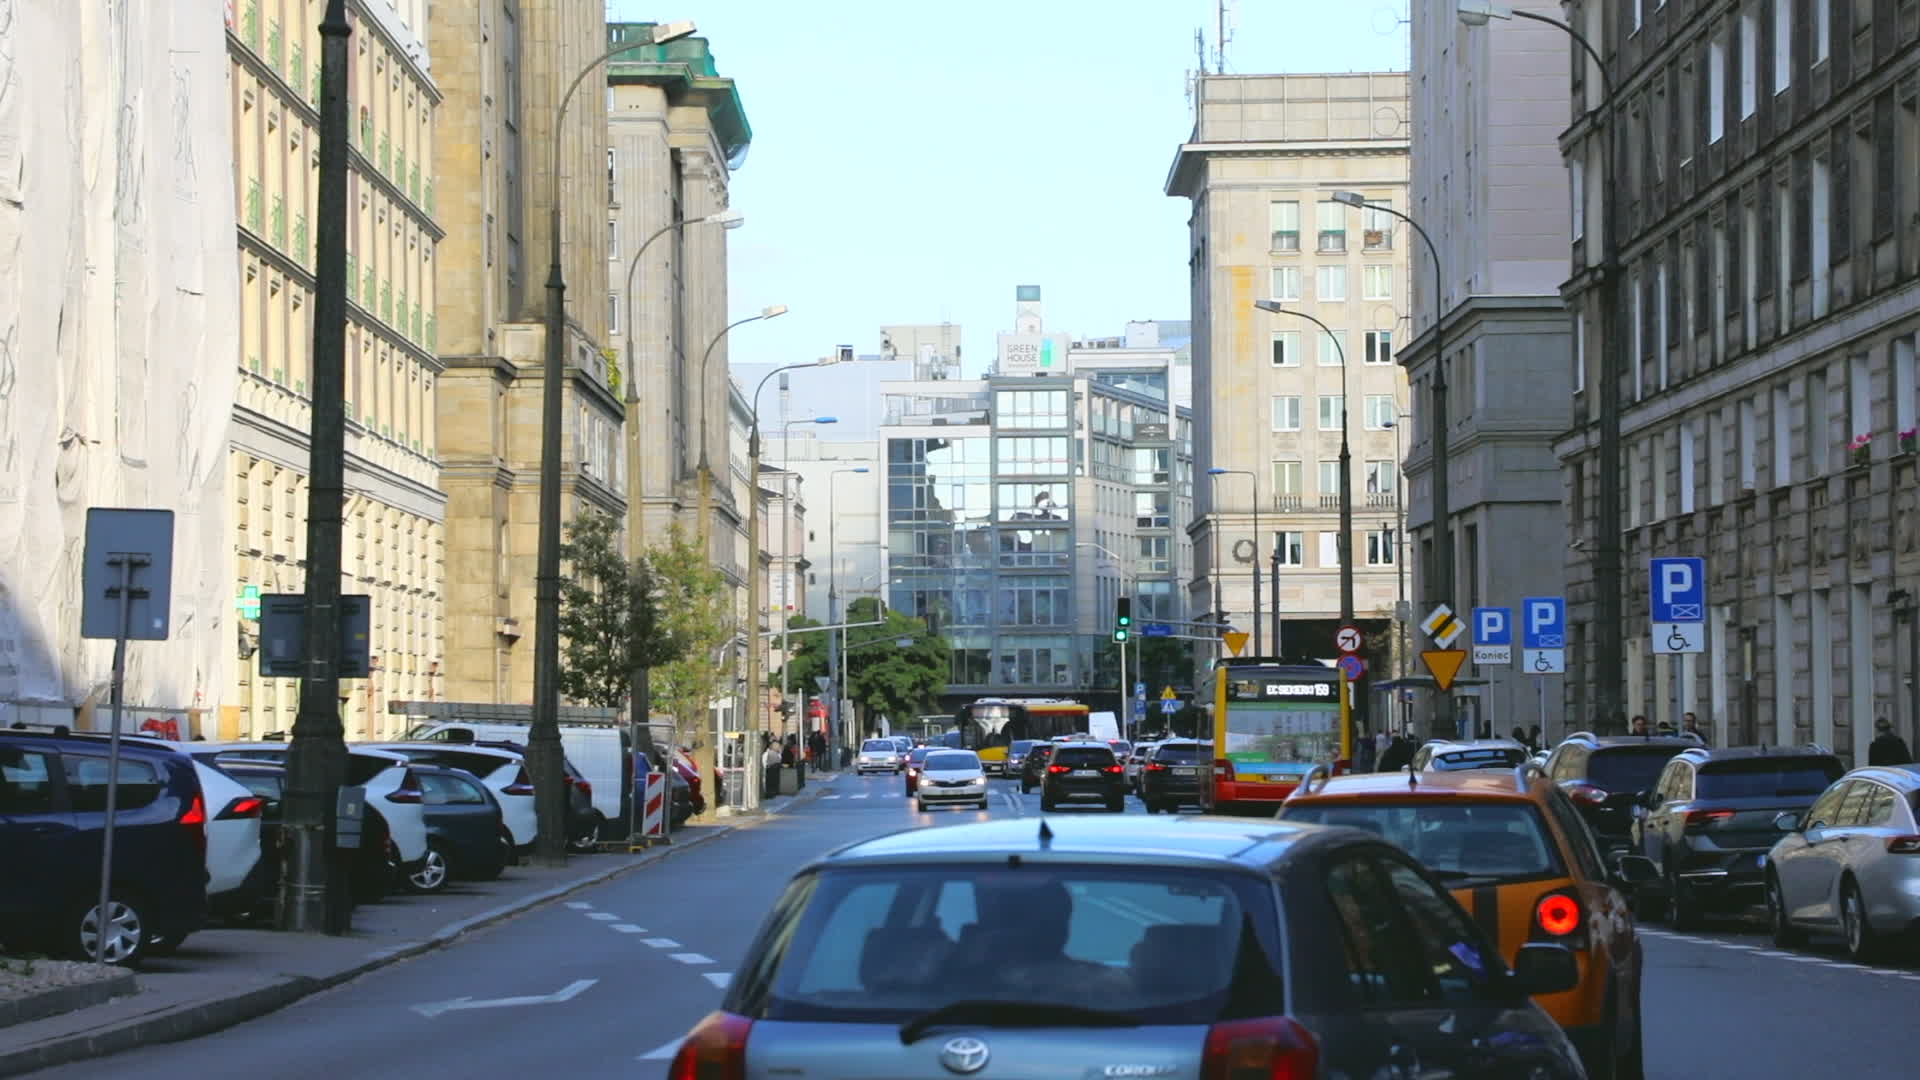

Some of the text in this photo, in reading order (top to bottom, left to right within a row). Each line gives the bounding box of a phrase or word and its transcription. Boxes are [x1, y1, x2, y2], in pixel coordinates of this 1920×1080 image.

[1007, 344, 1038, 353] GREEN
[1007, 354, 1038, 362] HOUSE
[1662, 564, 1692, 604] P
[1481, 611, 1503, 641] P
[1531, 602, 1555, 634] P
[1475, 651, 1509, 660] Koniec
